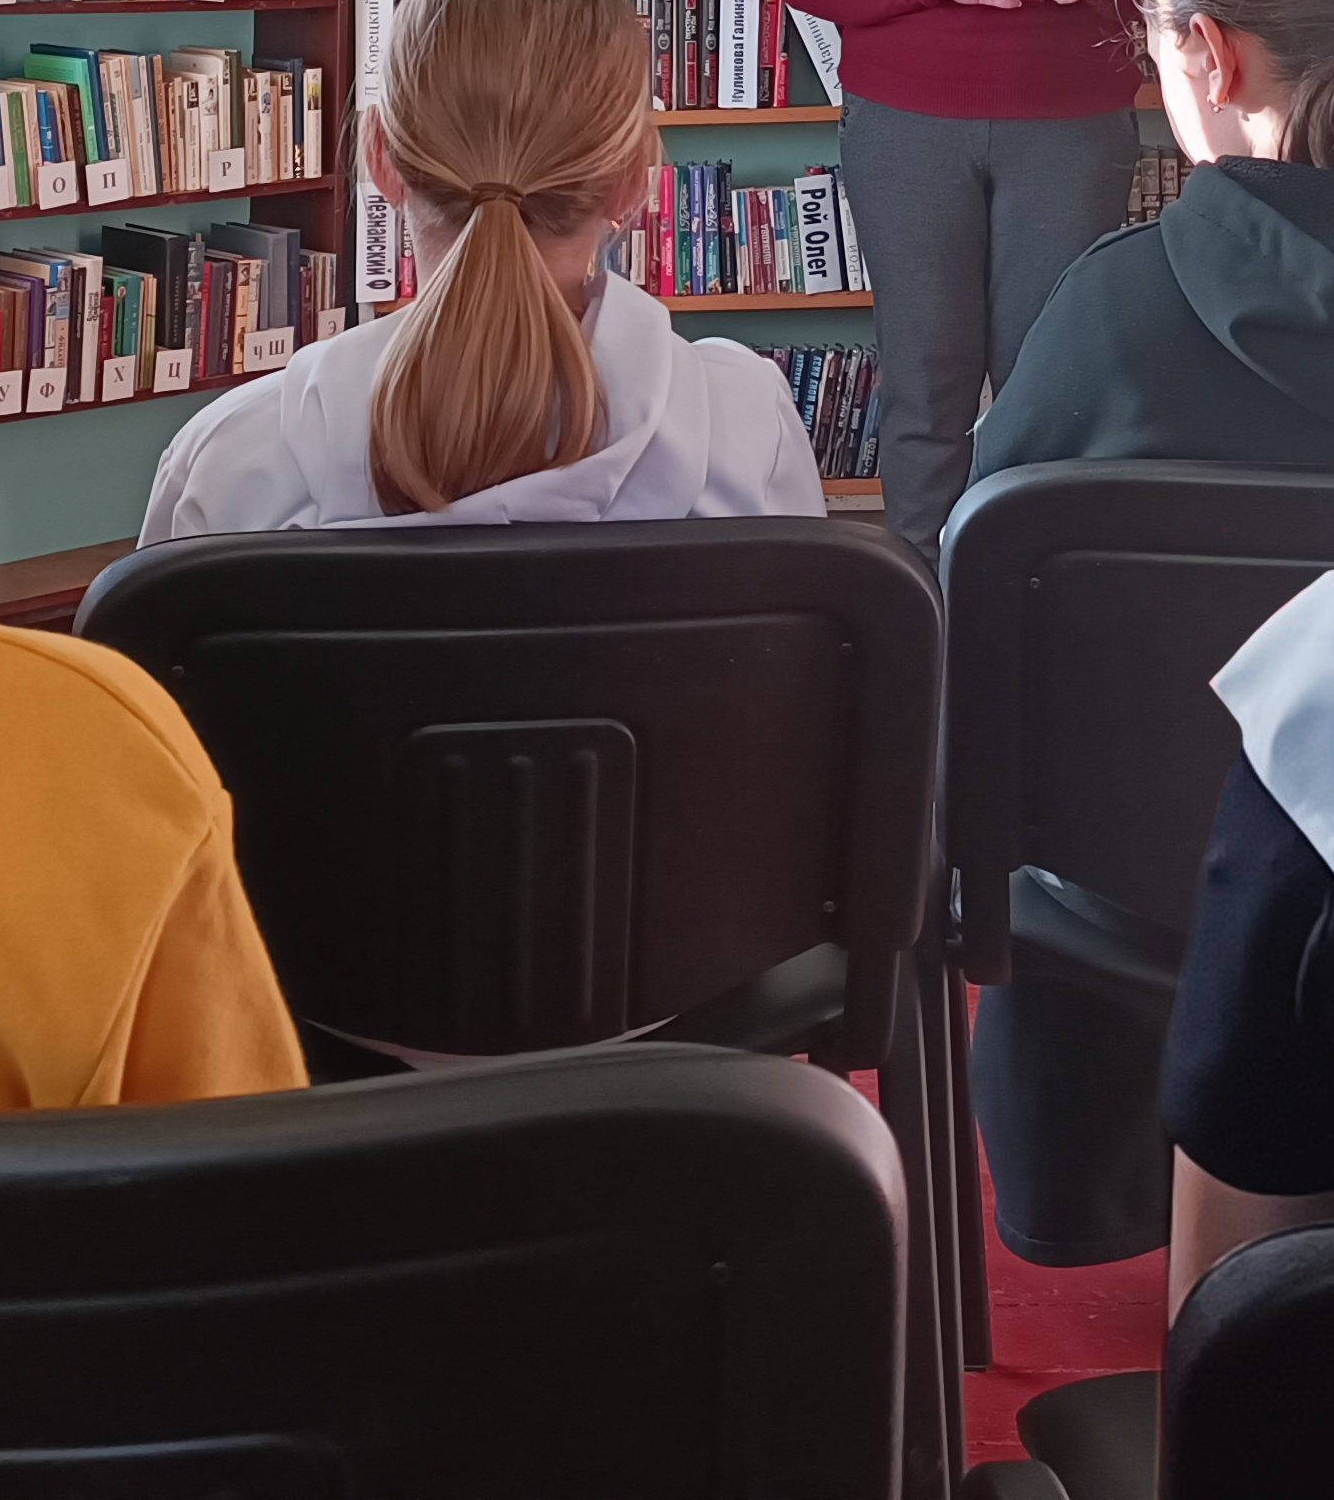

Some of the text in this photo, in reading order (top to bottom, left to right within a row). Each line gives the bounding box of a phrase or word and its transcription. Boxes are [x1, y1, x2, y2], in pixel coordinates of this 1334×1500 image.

[804, 13, 837, 73] Марини
[731, 47, 746, 104] Куликова
[221, 161, 232, 177] Р
[52, 177, 66, 194] О
[102, 172, 117, 190] П
[365, 194, 393, 290] Незнанский Ф
[801, 186, 830, 279] Рой Олег
[847, 243, 859, 283] Рой
[327, 319, 337, 336] Э
[268, 338, 285, 357] Ш
[112, 366, 126, 383] Х
[167, 361, 182, 381] Ц
[39, 380, 55, 399] Ф
